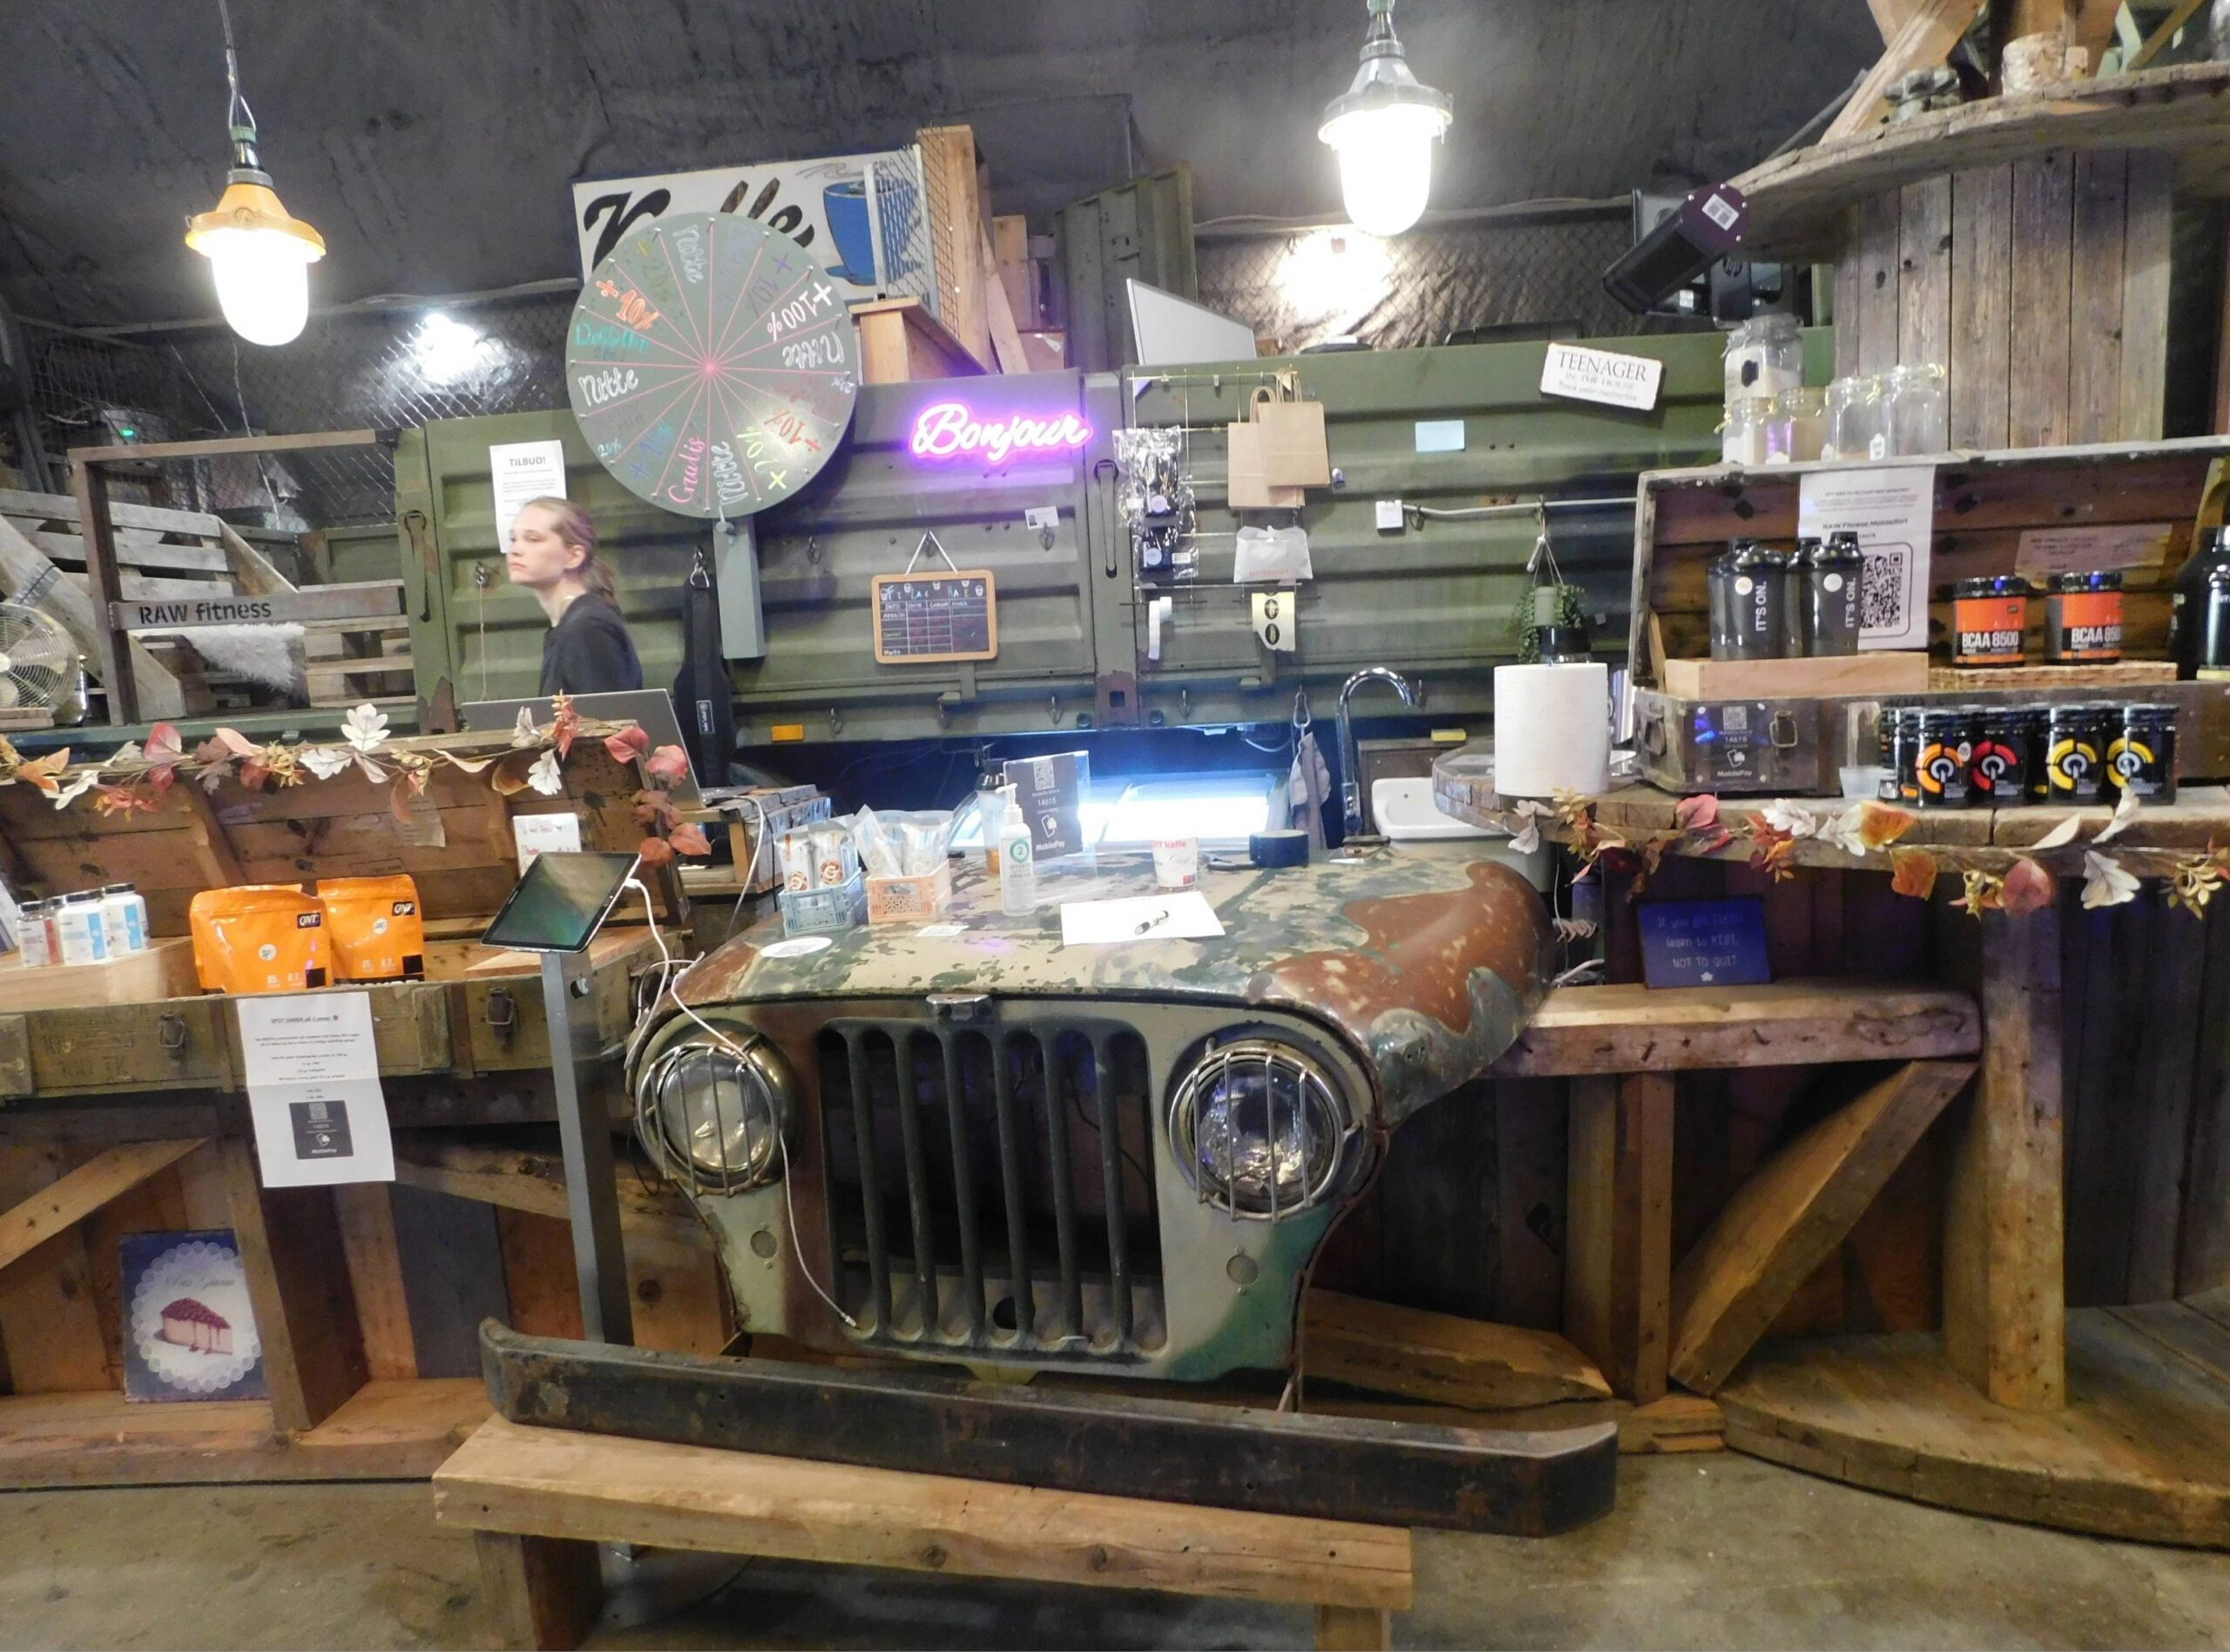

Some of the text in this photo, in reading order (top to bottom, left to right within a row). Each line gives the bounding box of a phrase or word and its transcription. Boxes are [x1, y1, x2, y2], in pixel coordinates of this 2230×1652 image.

[1558, 350, 1648, 382] TEENAGER
[578, 367, 639, 407] Nitte
[912, 402, 1090, 462] Bonjour
[509, 456, 546, 467] TILBUD!
[139, 601, 273, 624] RAW fitness
[1962, 630, 2019, 648] BCAA 8500
[2071, 626, 2104, 643] BCAA
[1036, 840, 1066, 852] MobilePay
[1672, 955, 1737, 968] NOT TO QUIT
